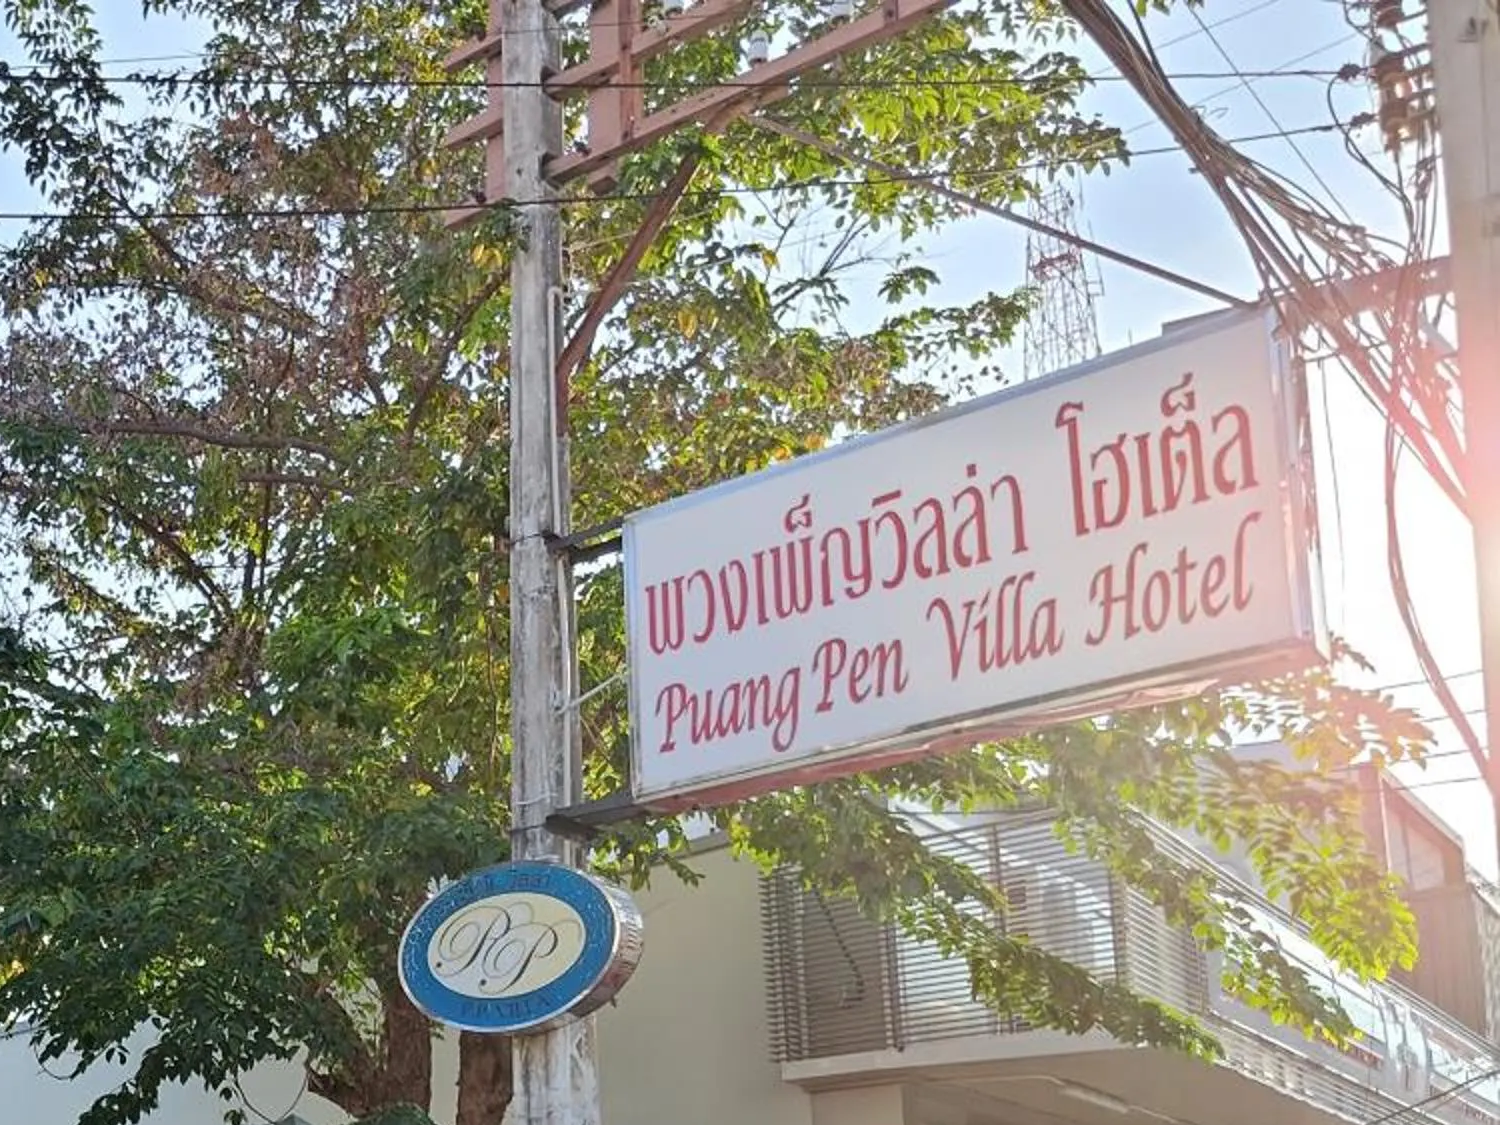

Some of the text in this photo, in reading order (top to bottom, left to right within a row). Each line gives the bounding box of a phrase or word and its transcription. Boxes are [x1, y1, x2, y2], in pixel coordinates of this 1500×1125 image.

[1055, 372, 1260, 537] โฮเต็ล
[655, 511, 1262, 754] Puang Pen Villa Hotel
